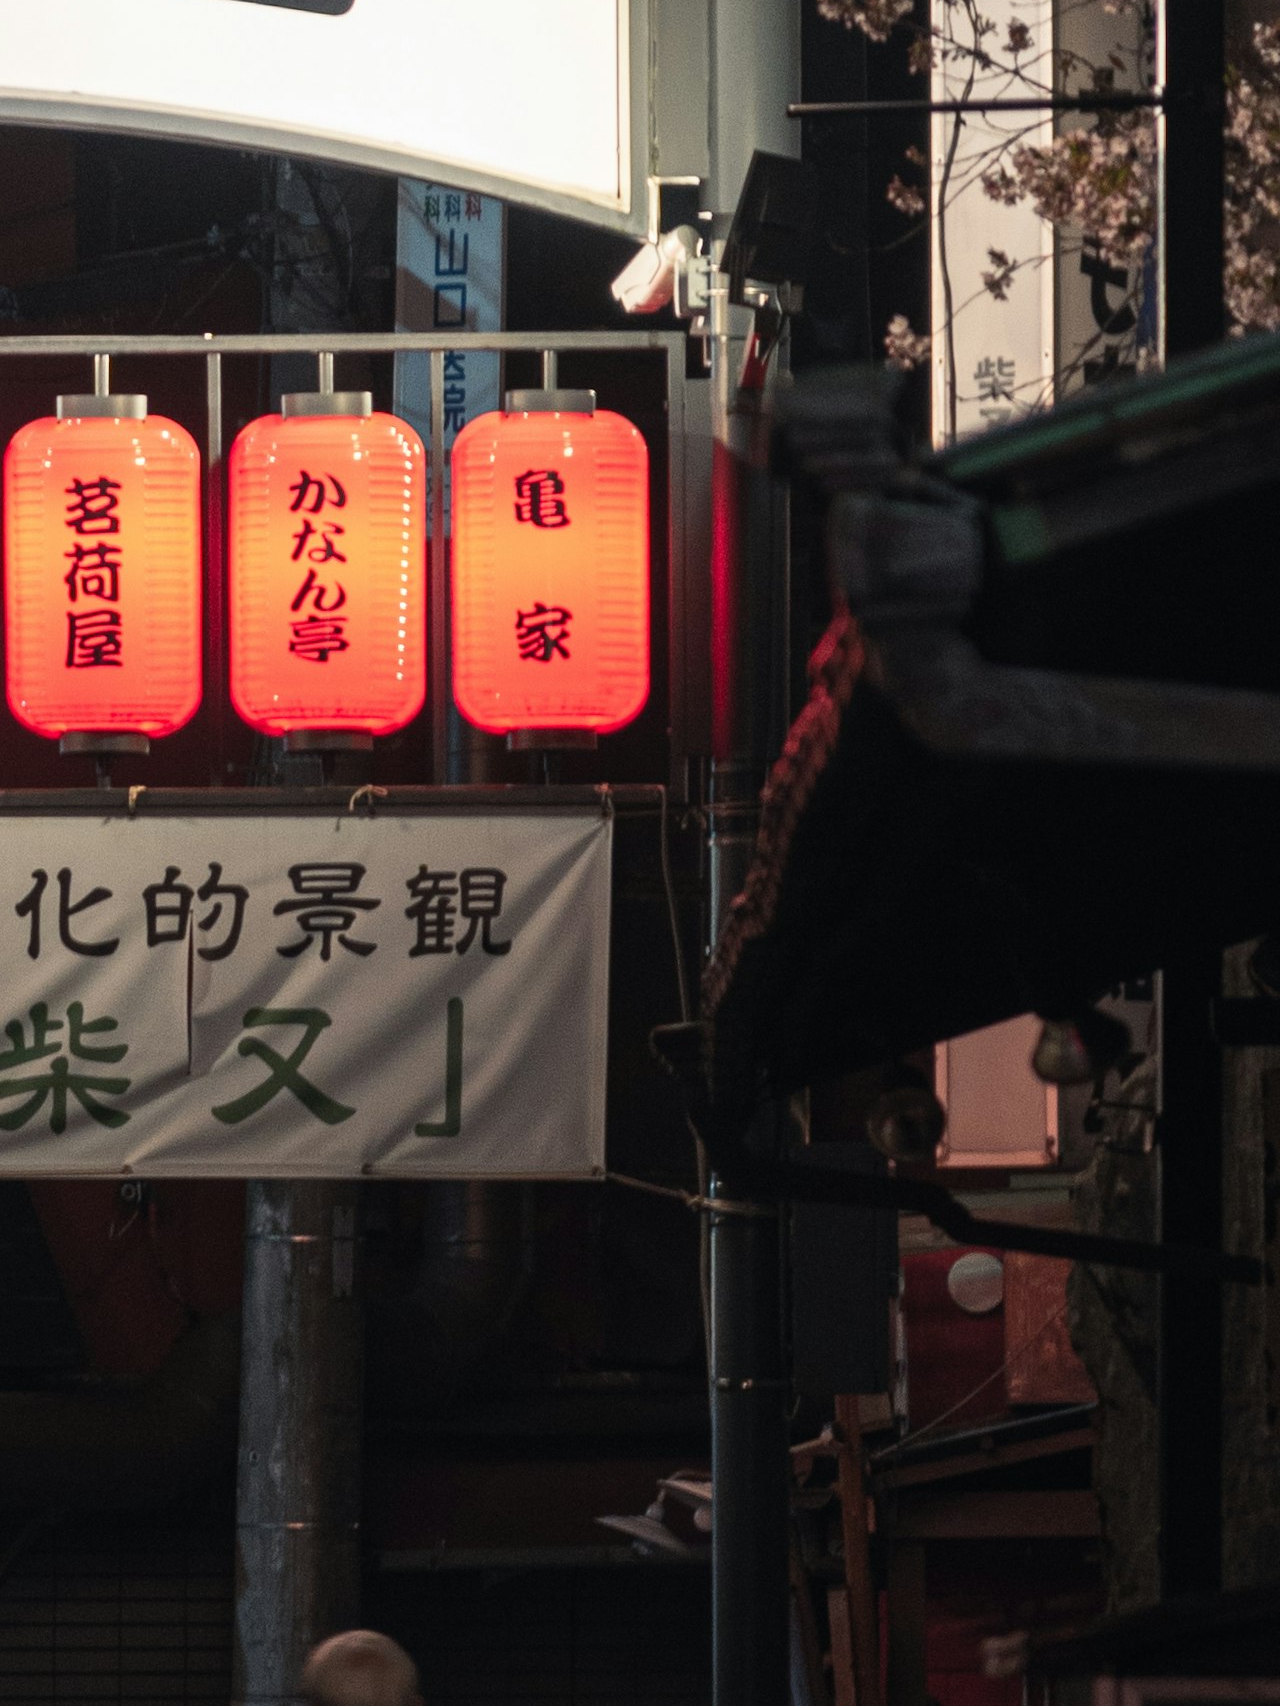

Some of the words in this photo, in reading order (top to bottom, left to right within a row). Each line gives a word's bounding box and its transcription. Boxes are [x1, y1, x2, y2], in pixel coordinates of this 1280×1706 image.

[64, 476, 124, 669] 茗荷屋
[288, 470, 350, 663] かなん亭
[514, 469, 573, 663] 亀家
